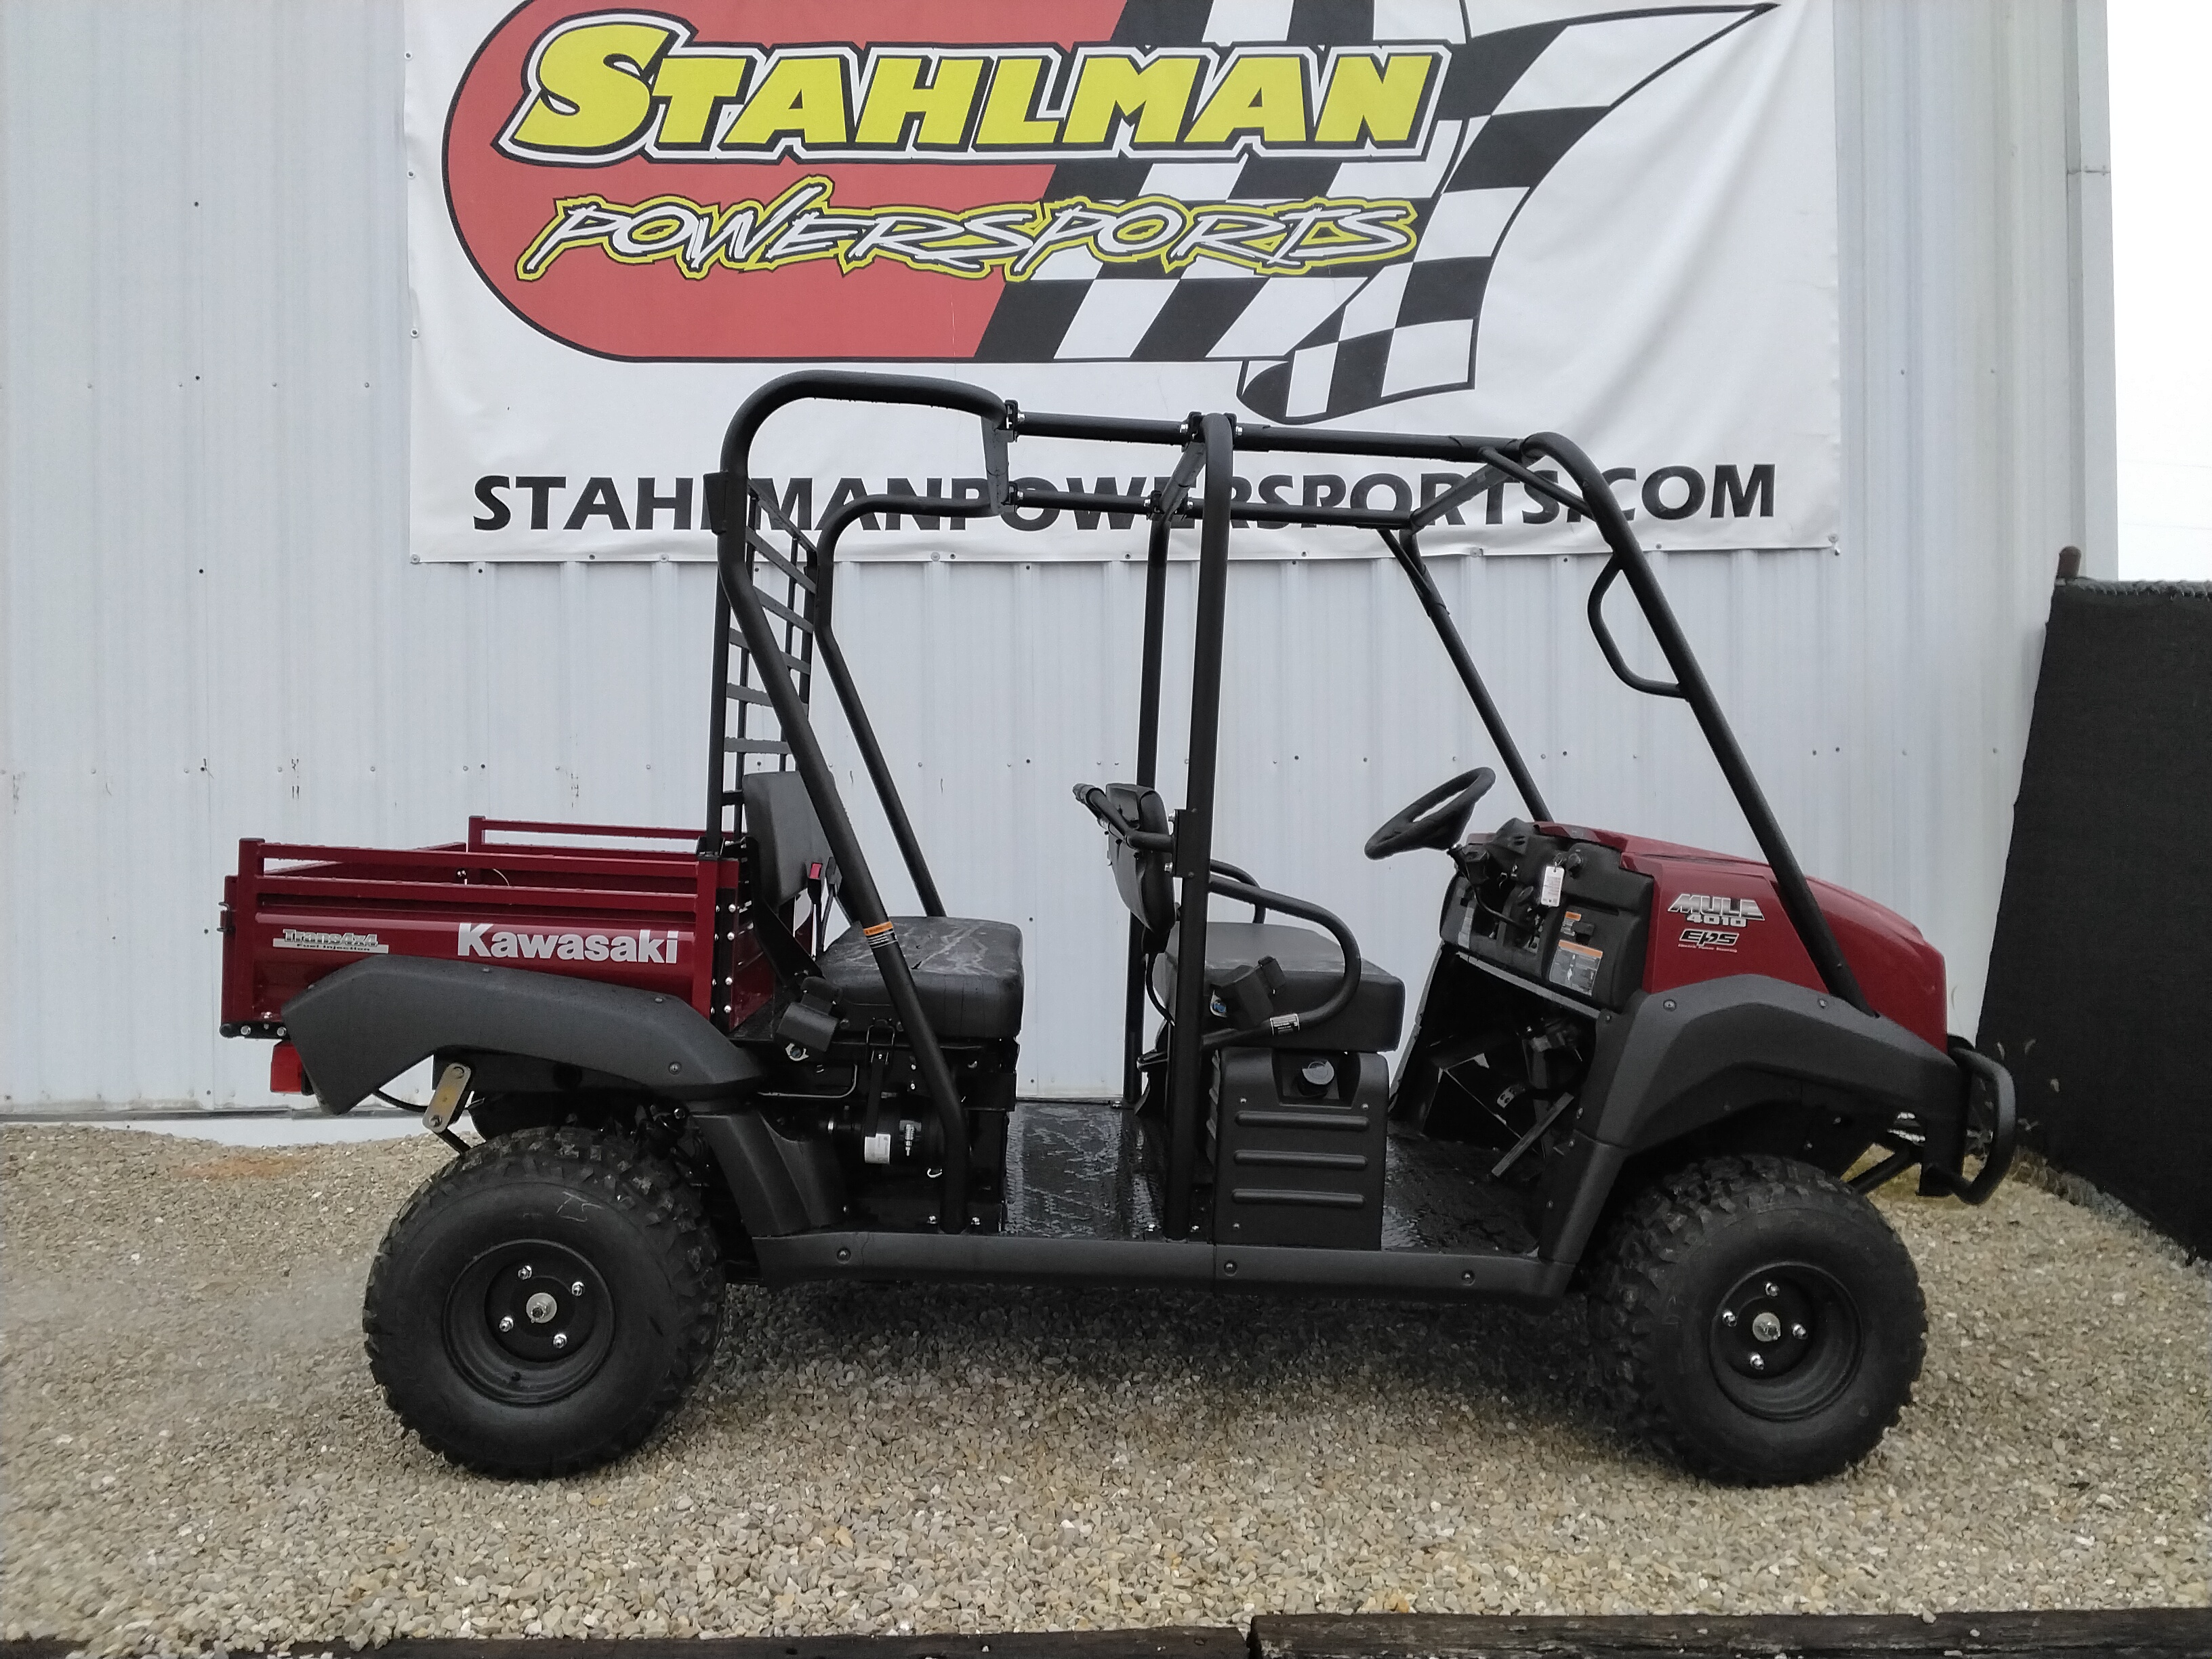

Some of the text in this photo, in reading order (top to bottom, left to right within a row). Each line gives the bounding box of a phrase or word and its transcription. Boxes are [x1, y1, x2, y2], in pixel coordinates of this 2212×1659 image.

[496, 12, 1452, 164] STAHLMAN
[516, 176, 1417, 280] POWERSPORTS
[472, 463, 1776, 531] STAHMANPOWSPORTS.OM
[1668, 894, 1765, 920] MULE
[1686, 914, 1747, 928] 4010
[283, 928, 378, 947] Trans4x4
[457, 922, 678, 964] Kawasaki
